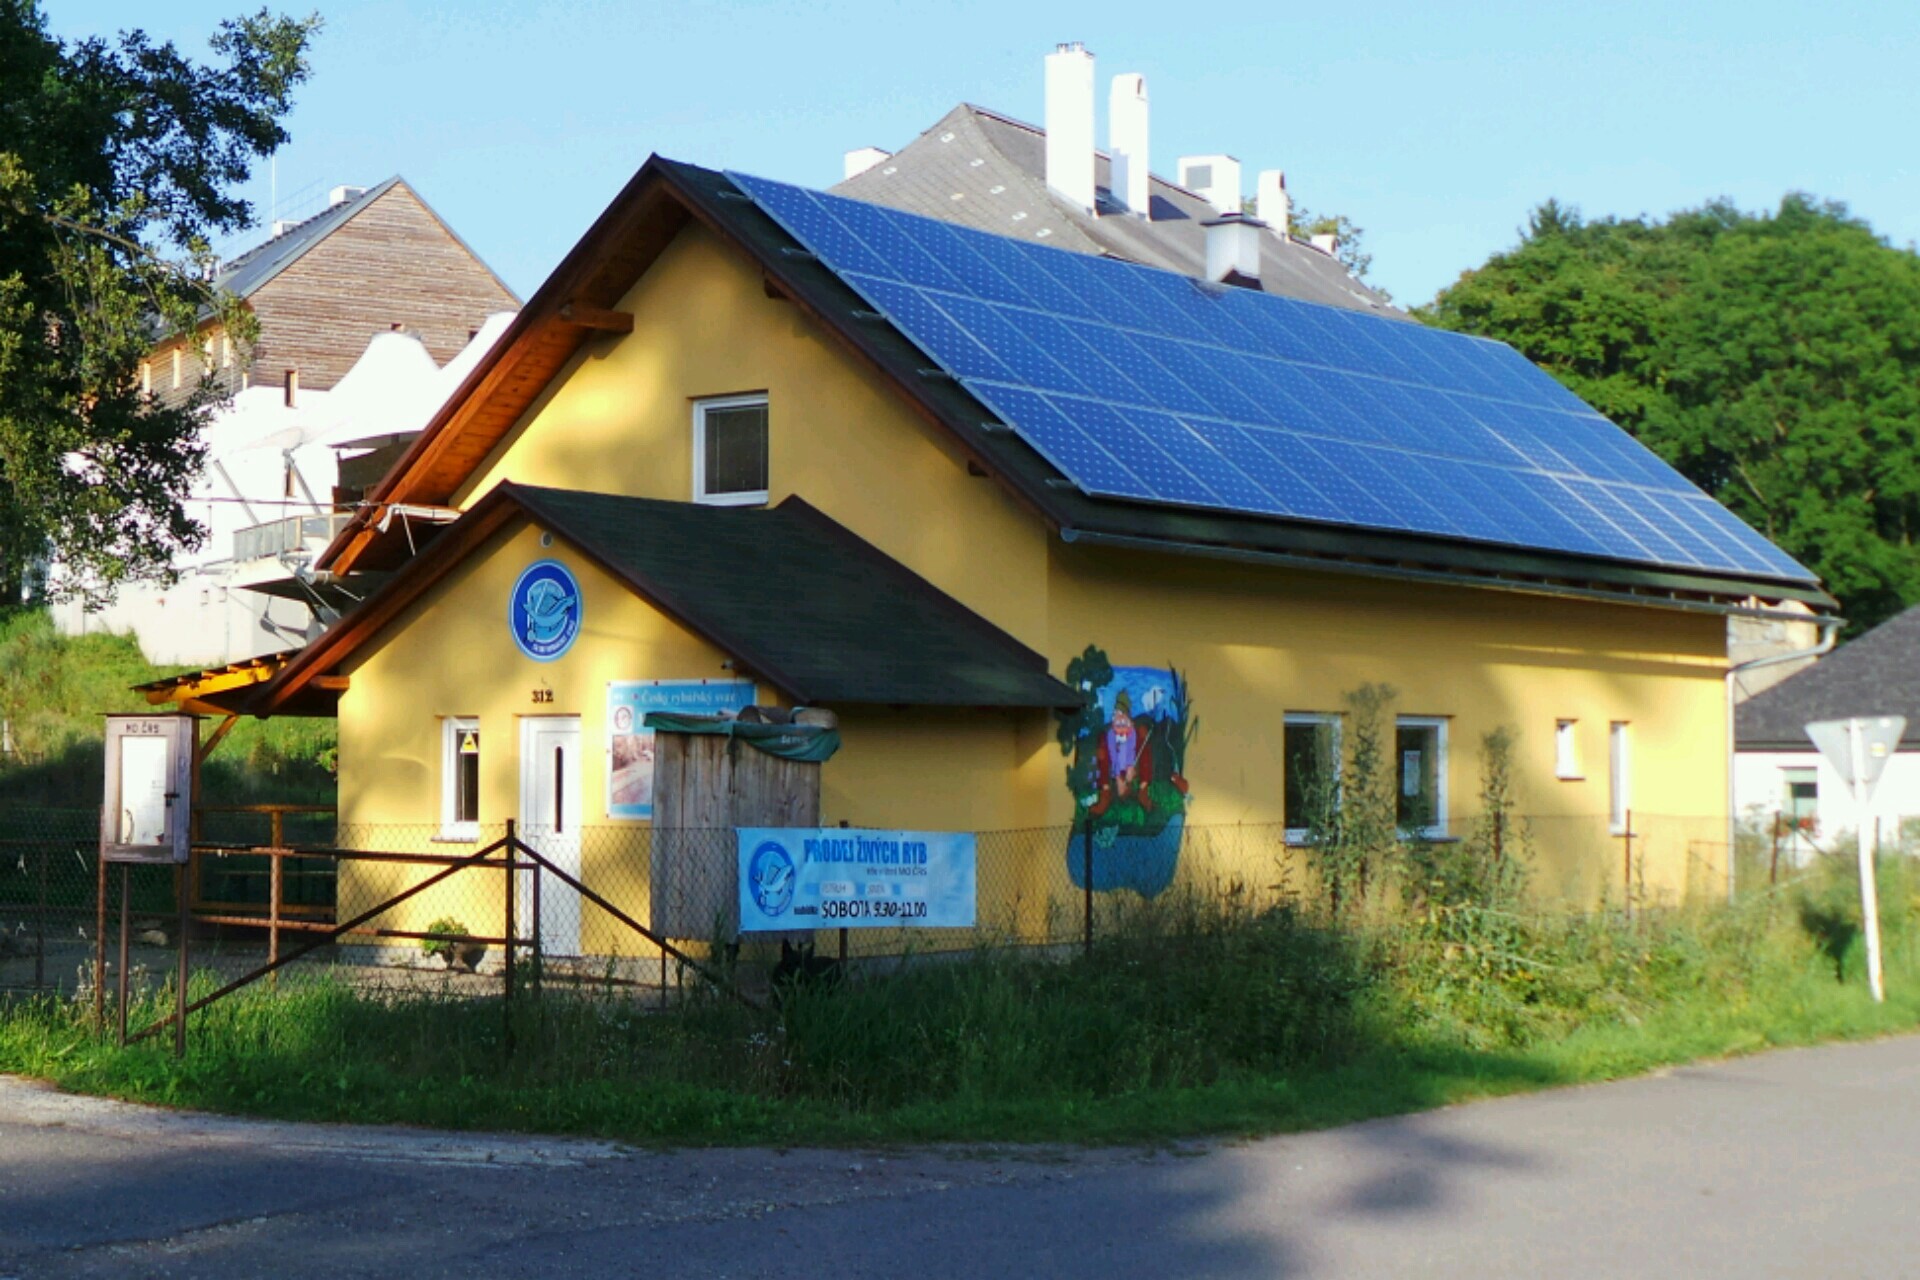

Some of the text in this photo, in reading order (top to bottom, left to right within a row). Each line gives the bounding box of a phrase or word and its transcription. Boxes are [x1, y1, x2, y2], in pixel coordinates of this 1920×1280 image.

[532, 690, 553, 703] 312
[804, 839, 854, 862] PRODEJ
[903, 841, 927, 864] RYB
[822, 900, 871, 919] SOBOTA
